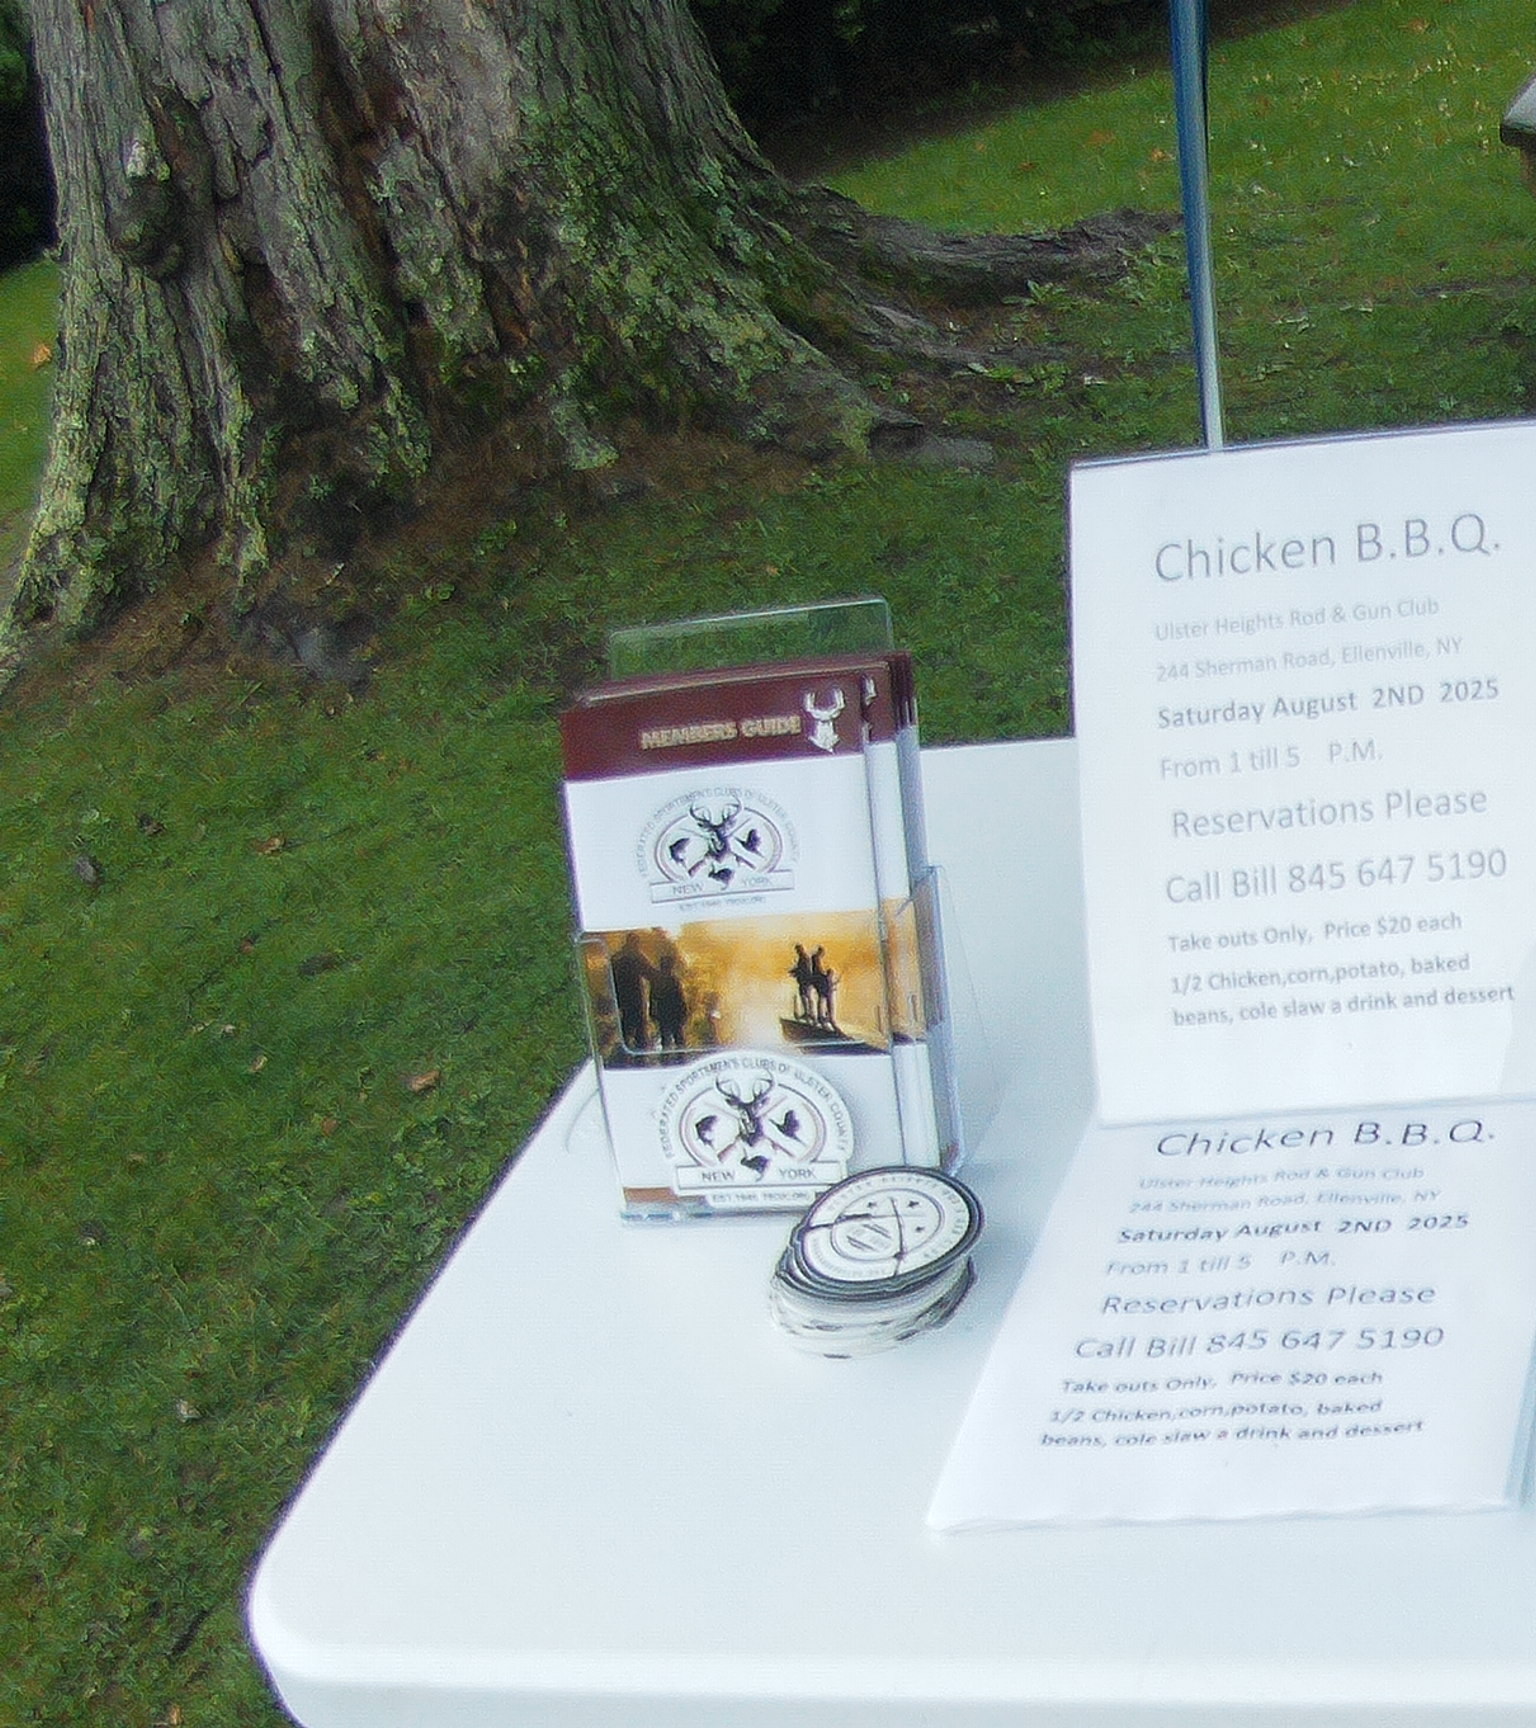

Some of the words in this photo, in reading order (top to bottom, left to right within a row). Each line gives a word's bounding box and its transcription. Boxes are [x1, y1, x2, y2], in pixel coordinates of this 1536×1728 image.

[1155, 531, 1335, 582] Chicken
[1357, 513, 1500, 562] B.B.Q.
[1154, 621, 1209, 641] Ulster
[1214, 612, 1284, 636] Heights
[1290, 607, 1326, 626] Rod
[1331, 604, 1346, 623] &
[1352, 603, 1391, 621] Gun
[1396, 596, 1439, 617] Club
[1157, 662, 1189, 682] 244
[1195, 656, 1277, 678] Sherman
[1436, 637, 1462, 655] NY
[1158, 700, 1265, 729] Saturday
[1273, 692, 1357, 719] August
[1373, 684, 1424, 708] 2ND
[1441, 678, 1499, 702] 2025
[642, 721, 738, 749] MEMBERS
[741, 715, 800, 737] GUIDE
[1160, 757, 1220, 779] From
[1230, 750, 1241, 773] 1
[1249, 746, 1278, 771] till
[1286, 745, 1300, 768] 5
[1172, 799, 1374, 838] Reservations
[1385, 789, 1487, 819] Please
[1165, 871, 1220, 903] Call
[1232, 865, 1276, 898] Bill
[1288, 861, 1345, 893] 845
[1357, 855, 1415, 887] 647
[1428, 848, 1507, 882] 5190
[1168, 933, 1211, 952] Take
[1217, 931, 1258, 948] outs
[1324, 921, 1371, 939] Price
[1376, 915, 1412, 937] $20
[1416, 911, 1462, 932] each
[1171, 974, 1202, 996] 1/2
[1411, 953, 1470, 974] baked
[1238, 1001, 1277, 1020] cole
[1282, 998, 1325, 1017] slaw
[1330, 1000, 1342, 1014] a
[1347, 992, 1397, 1012] drink
[1403, 989, 1438, 1008] and
[1443, 986, 1514, 1005] dessert
[1157, 1128, 1334, 1155] Chicken
[1354, 1120, 1493, 1145] B.B.Q.
[702, 1171, 736, 1181] NEW
[779, 1168, 816, 1178] YORK
[1101, 1289, 1313, 1314] Reservations
[1327, 1286, 1435, 1305] Please
[1075, 1337, 1136, 1358] Call
[1146, 1336, 1197, 1358] Bill
[1206, 1329, 1267, 1353] 845
[1281, 1330, 1346, 1349] 647
[1357, 1327, 1444, 1349] 5190
